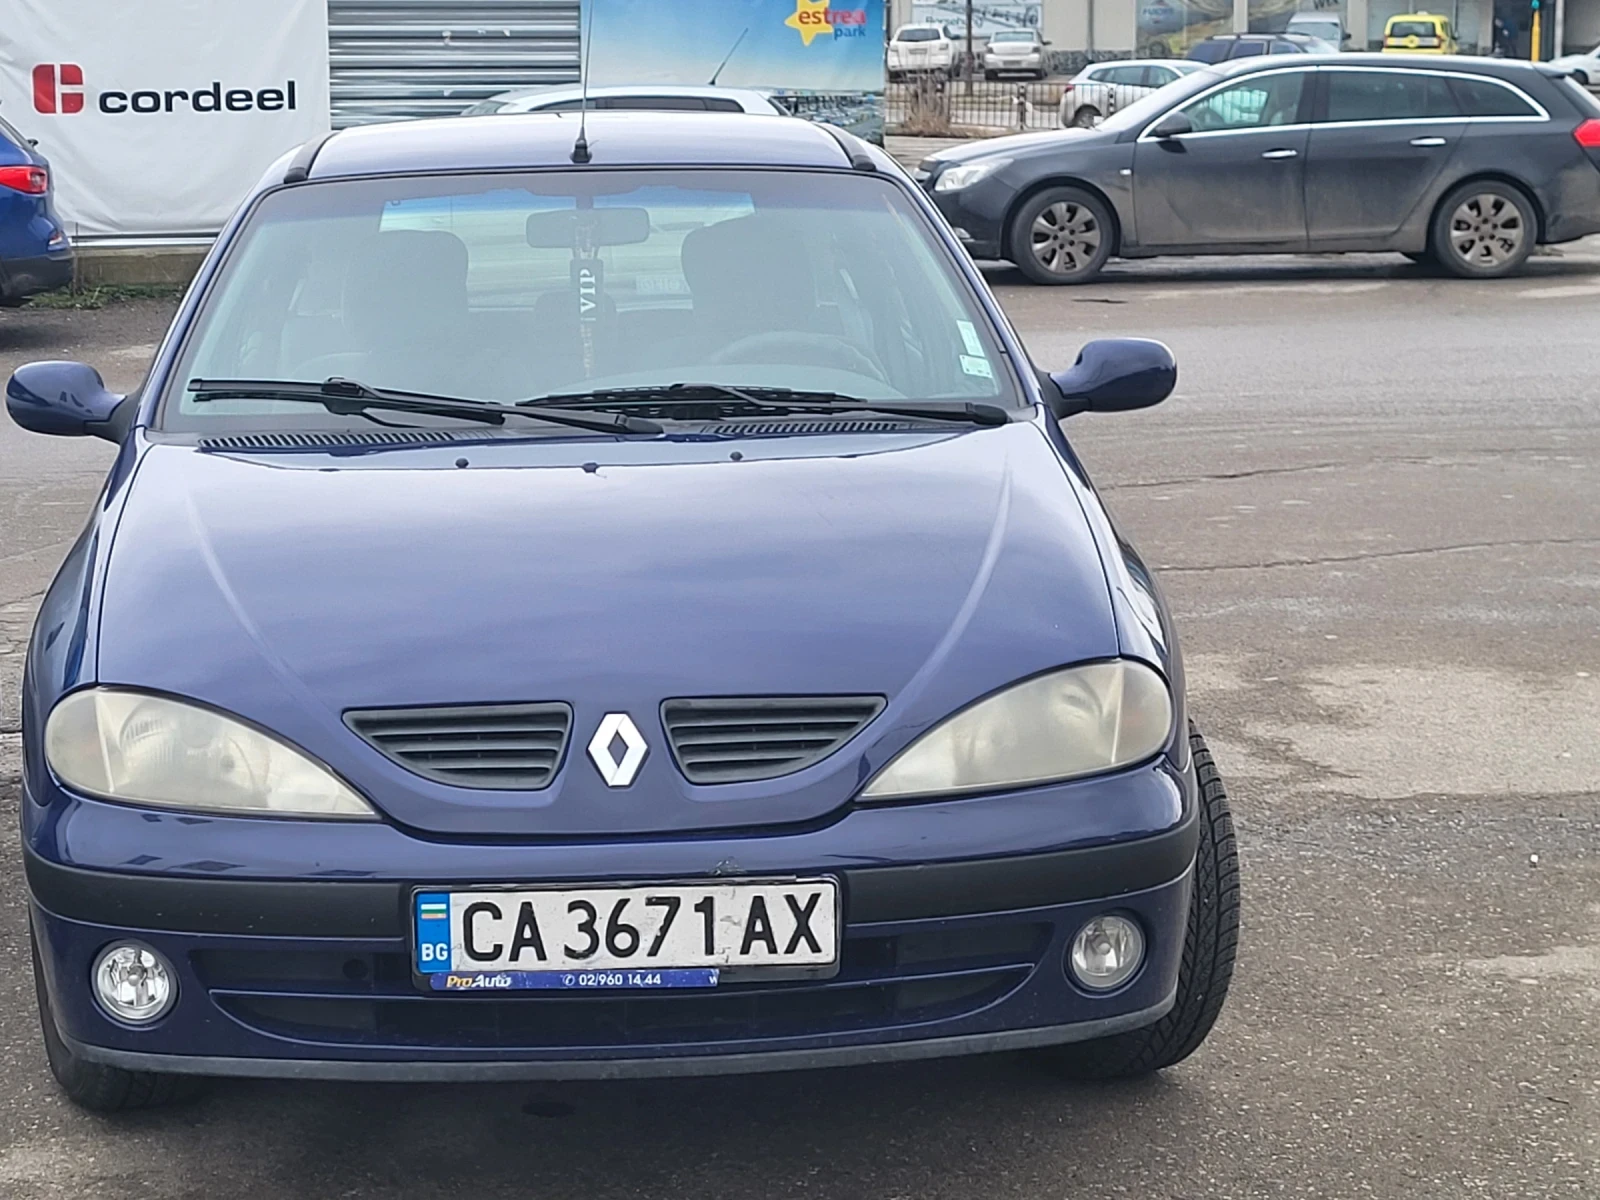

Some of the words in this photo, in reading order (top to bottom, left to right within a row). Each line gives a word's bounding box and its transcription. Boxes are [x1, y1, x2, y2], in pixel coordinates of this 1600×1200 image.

[798, 7, 866, 25] estrea
[833, 24, 866, 41] park
[99, 80, 296, 113] cordeel
[579, 268, 596, 314] VIP
[462, 901, 547, 962] CA
[563, 896, 716, 960] 3671
[739, 892, 823, 955] AX
[421, 943, 448, 961] BG
[579, 974, 623, 986] 02/960
